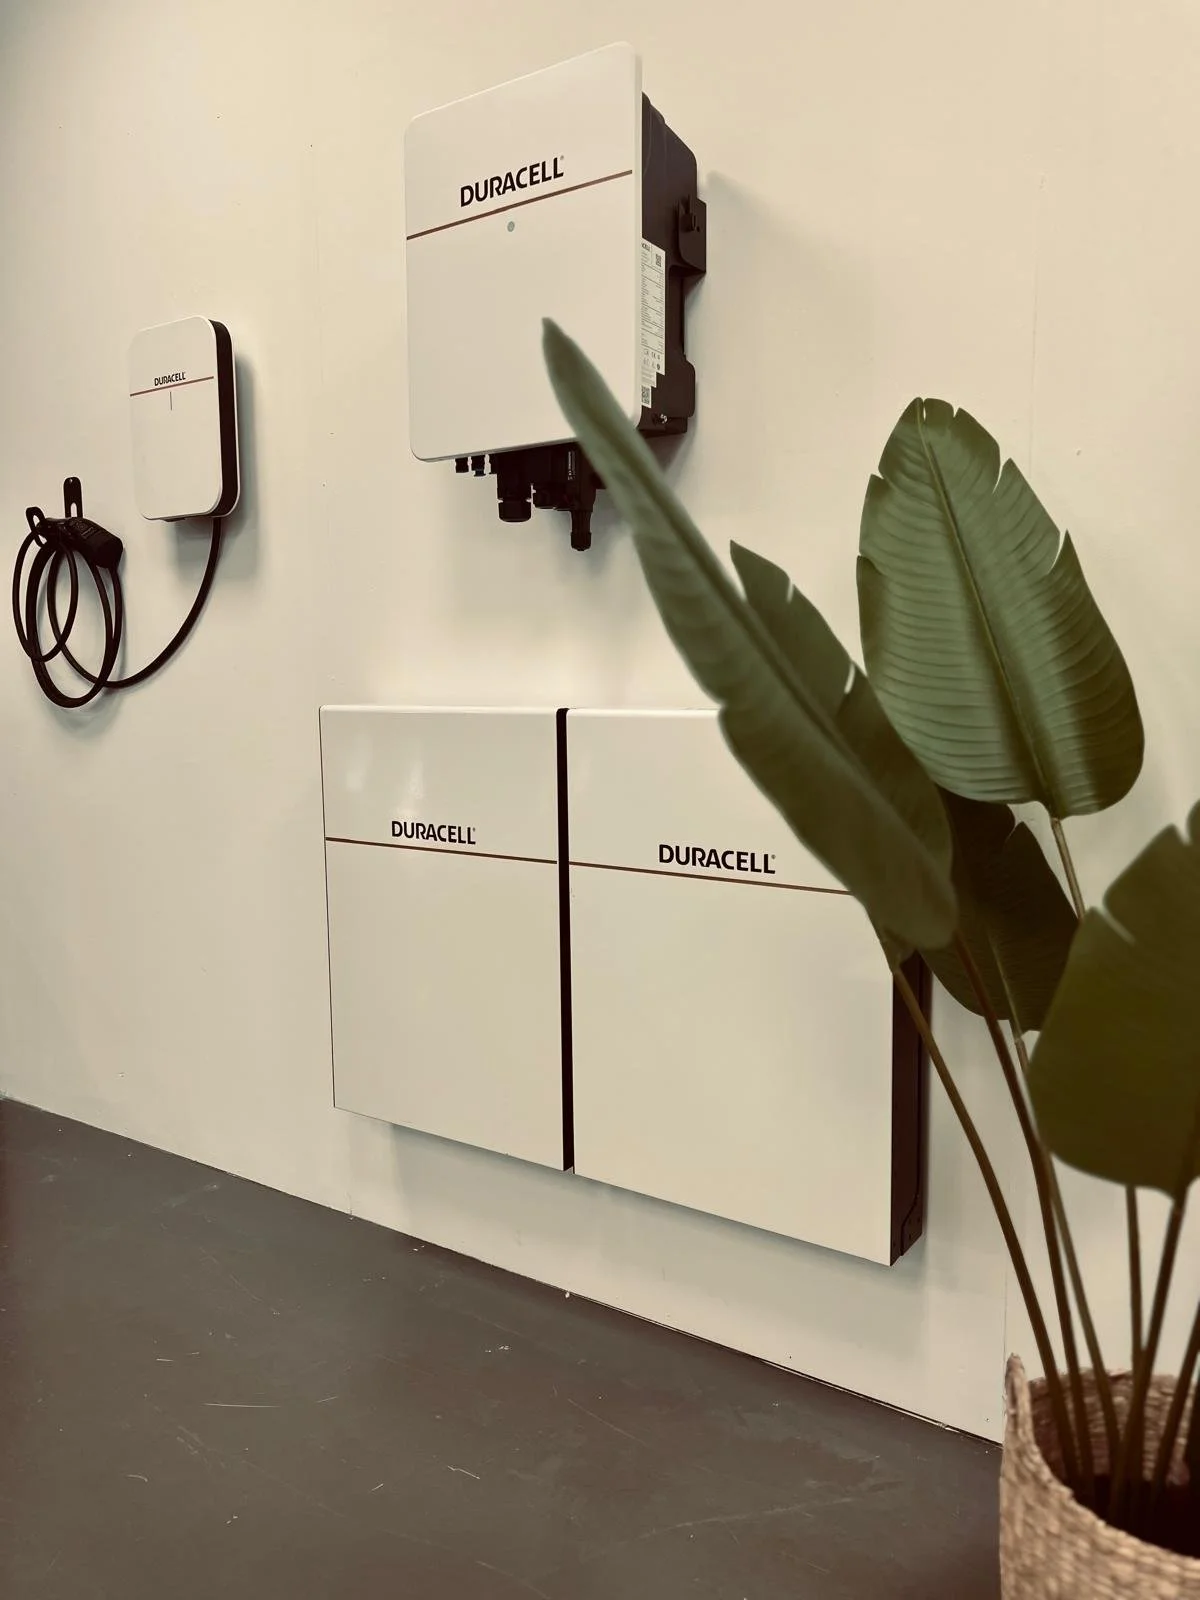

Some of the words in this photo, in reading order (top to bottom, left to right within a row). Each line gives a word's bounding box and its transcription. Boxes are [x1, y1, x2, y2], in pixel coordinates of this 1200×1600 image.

[461, 157, 564, 207] DURACELL
[154, 372, 186, 386] DURACELL
[392, 821, 476, 845] DURACELL
[659, 844, 775, 874] DURACELL
